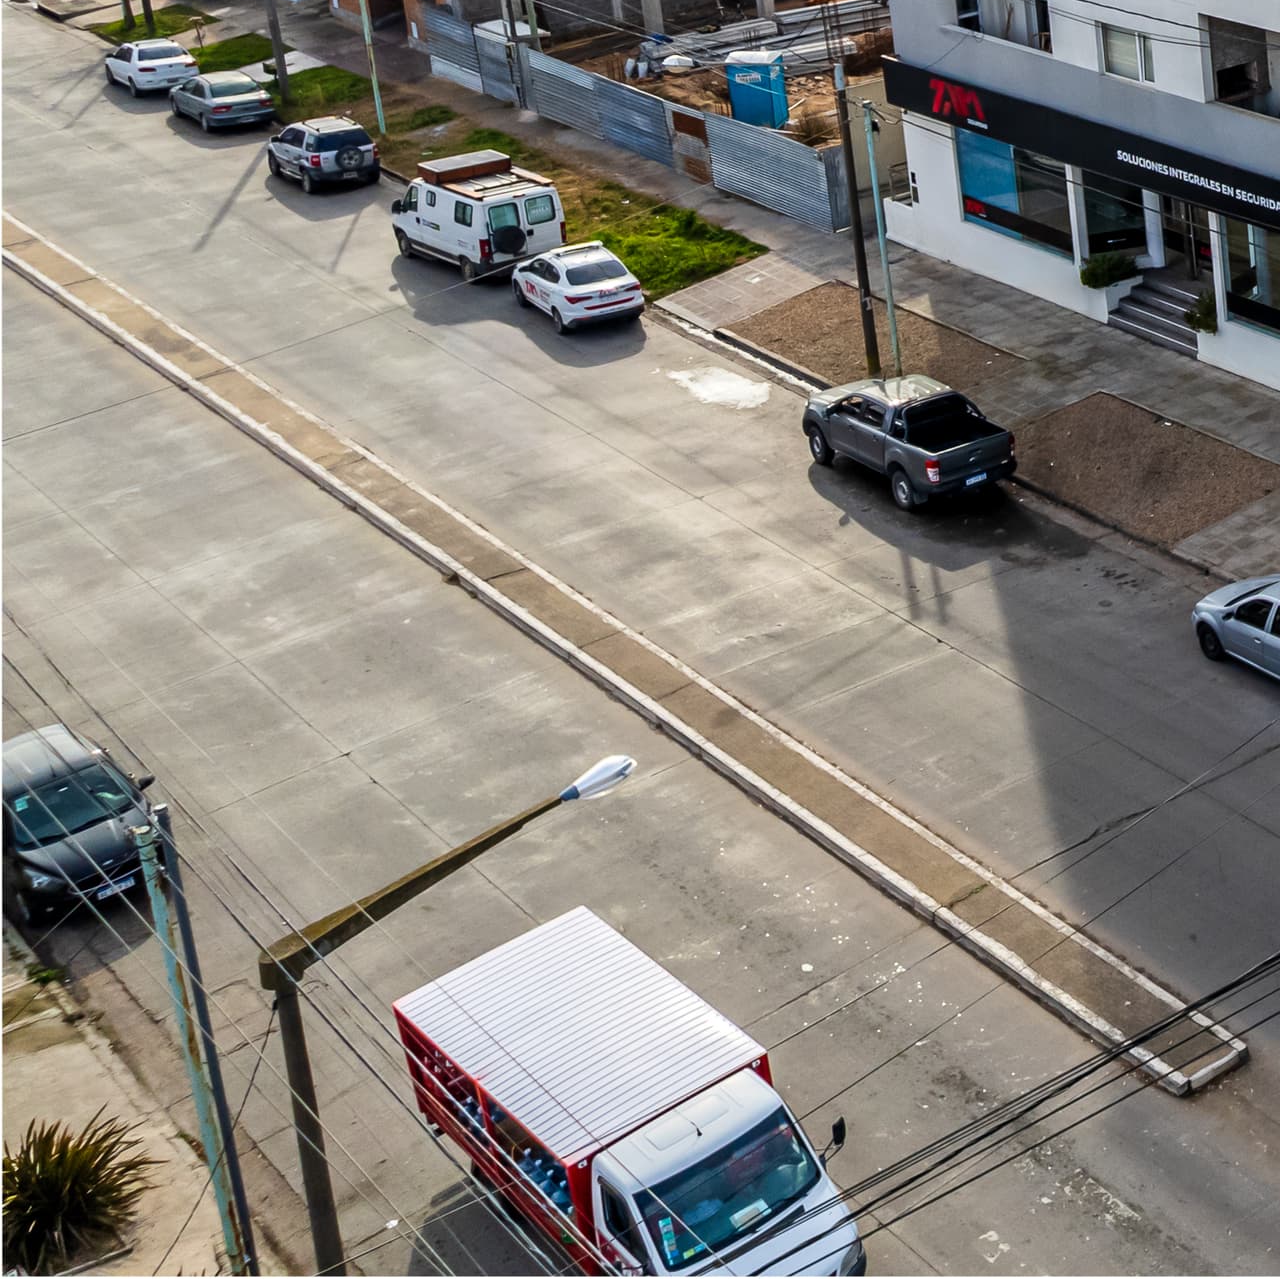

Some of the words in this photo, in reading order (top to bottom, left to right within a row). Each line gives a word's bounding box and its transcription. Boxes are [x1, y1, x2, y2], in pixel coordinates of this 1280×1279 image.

[1117, 150, 1168, 176] SOLUCIONES
[1169, 167, 1221, 193] INTEGRALES
[1222, 184, 1234, 198] EN
